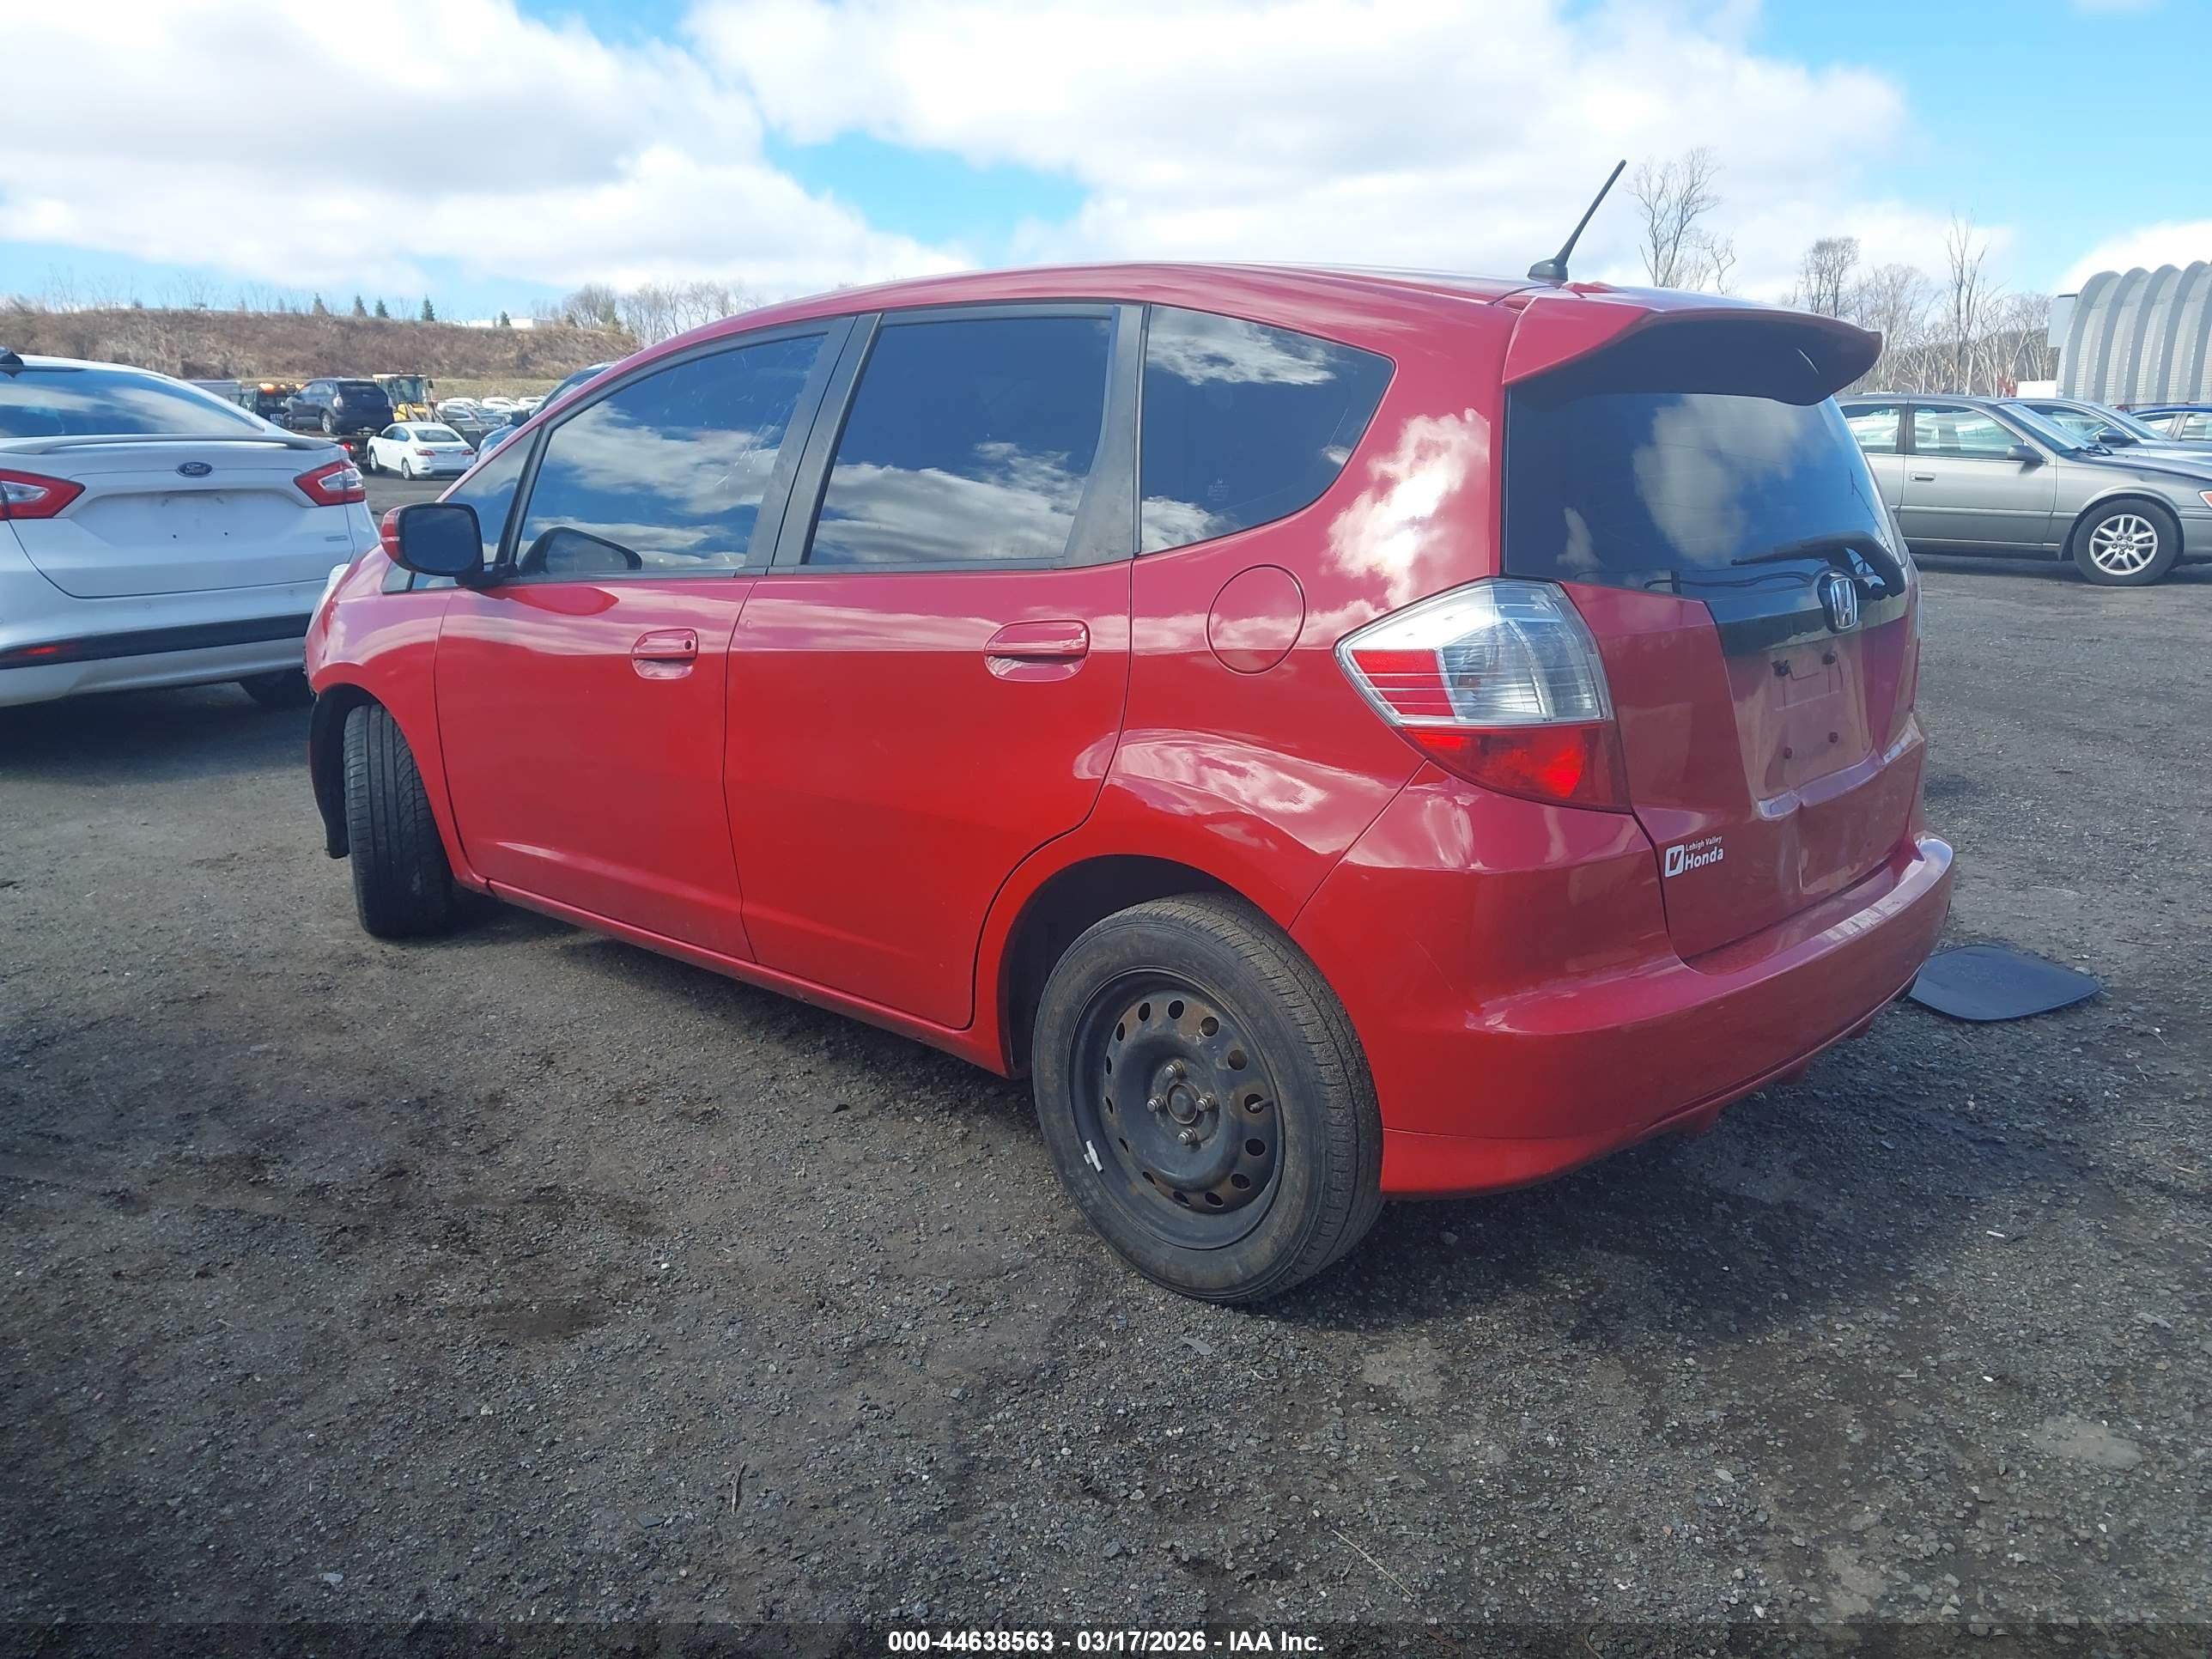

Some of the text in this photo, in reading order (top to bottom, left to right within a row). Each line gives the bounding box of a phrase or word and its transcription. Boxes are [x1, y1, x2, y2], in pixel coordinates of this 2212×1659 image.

[1686, 836, 1723, 852] Lehigh Valley
[1685, 846, 1724, 871] Honda
